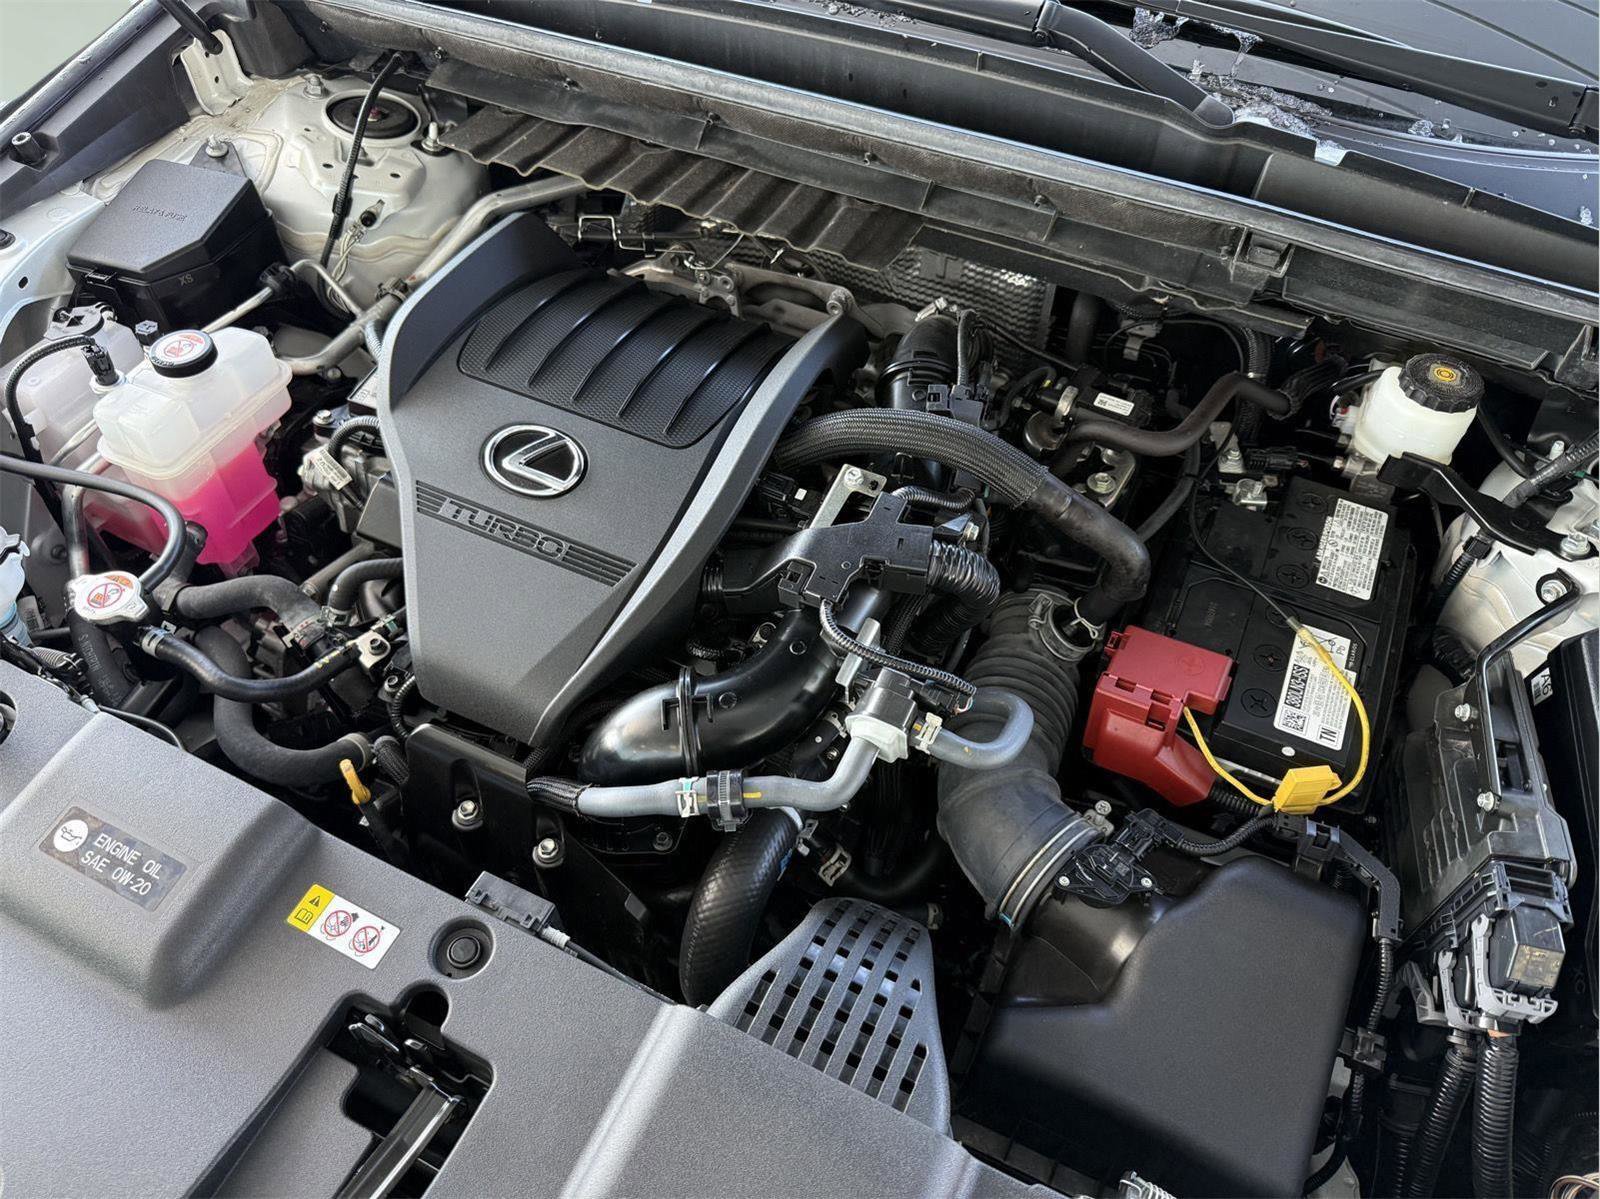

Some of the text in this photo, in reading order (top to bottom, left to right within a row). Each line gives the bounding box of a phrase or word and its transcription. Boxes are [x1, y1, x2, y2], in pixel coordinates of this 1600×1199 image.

[448, 499, 566, 560] TURBO
[1319, 726, 1338, 743] TN
[80, 850, 152, 896] SAE 0W-20
[93, 832, 162, 880] ENGINE OIL
